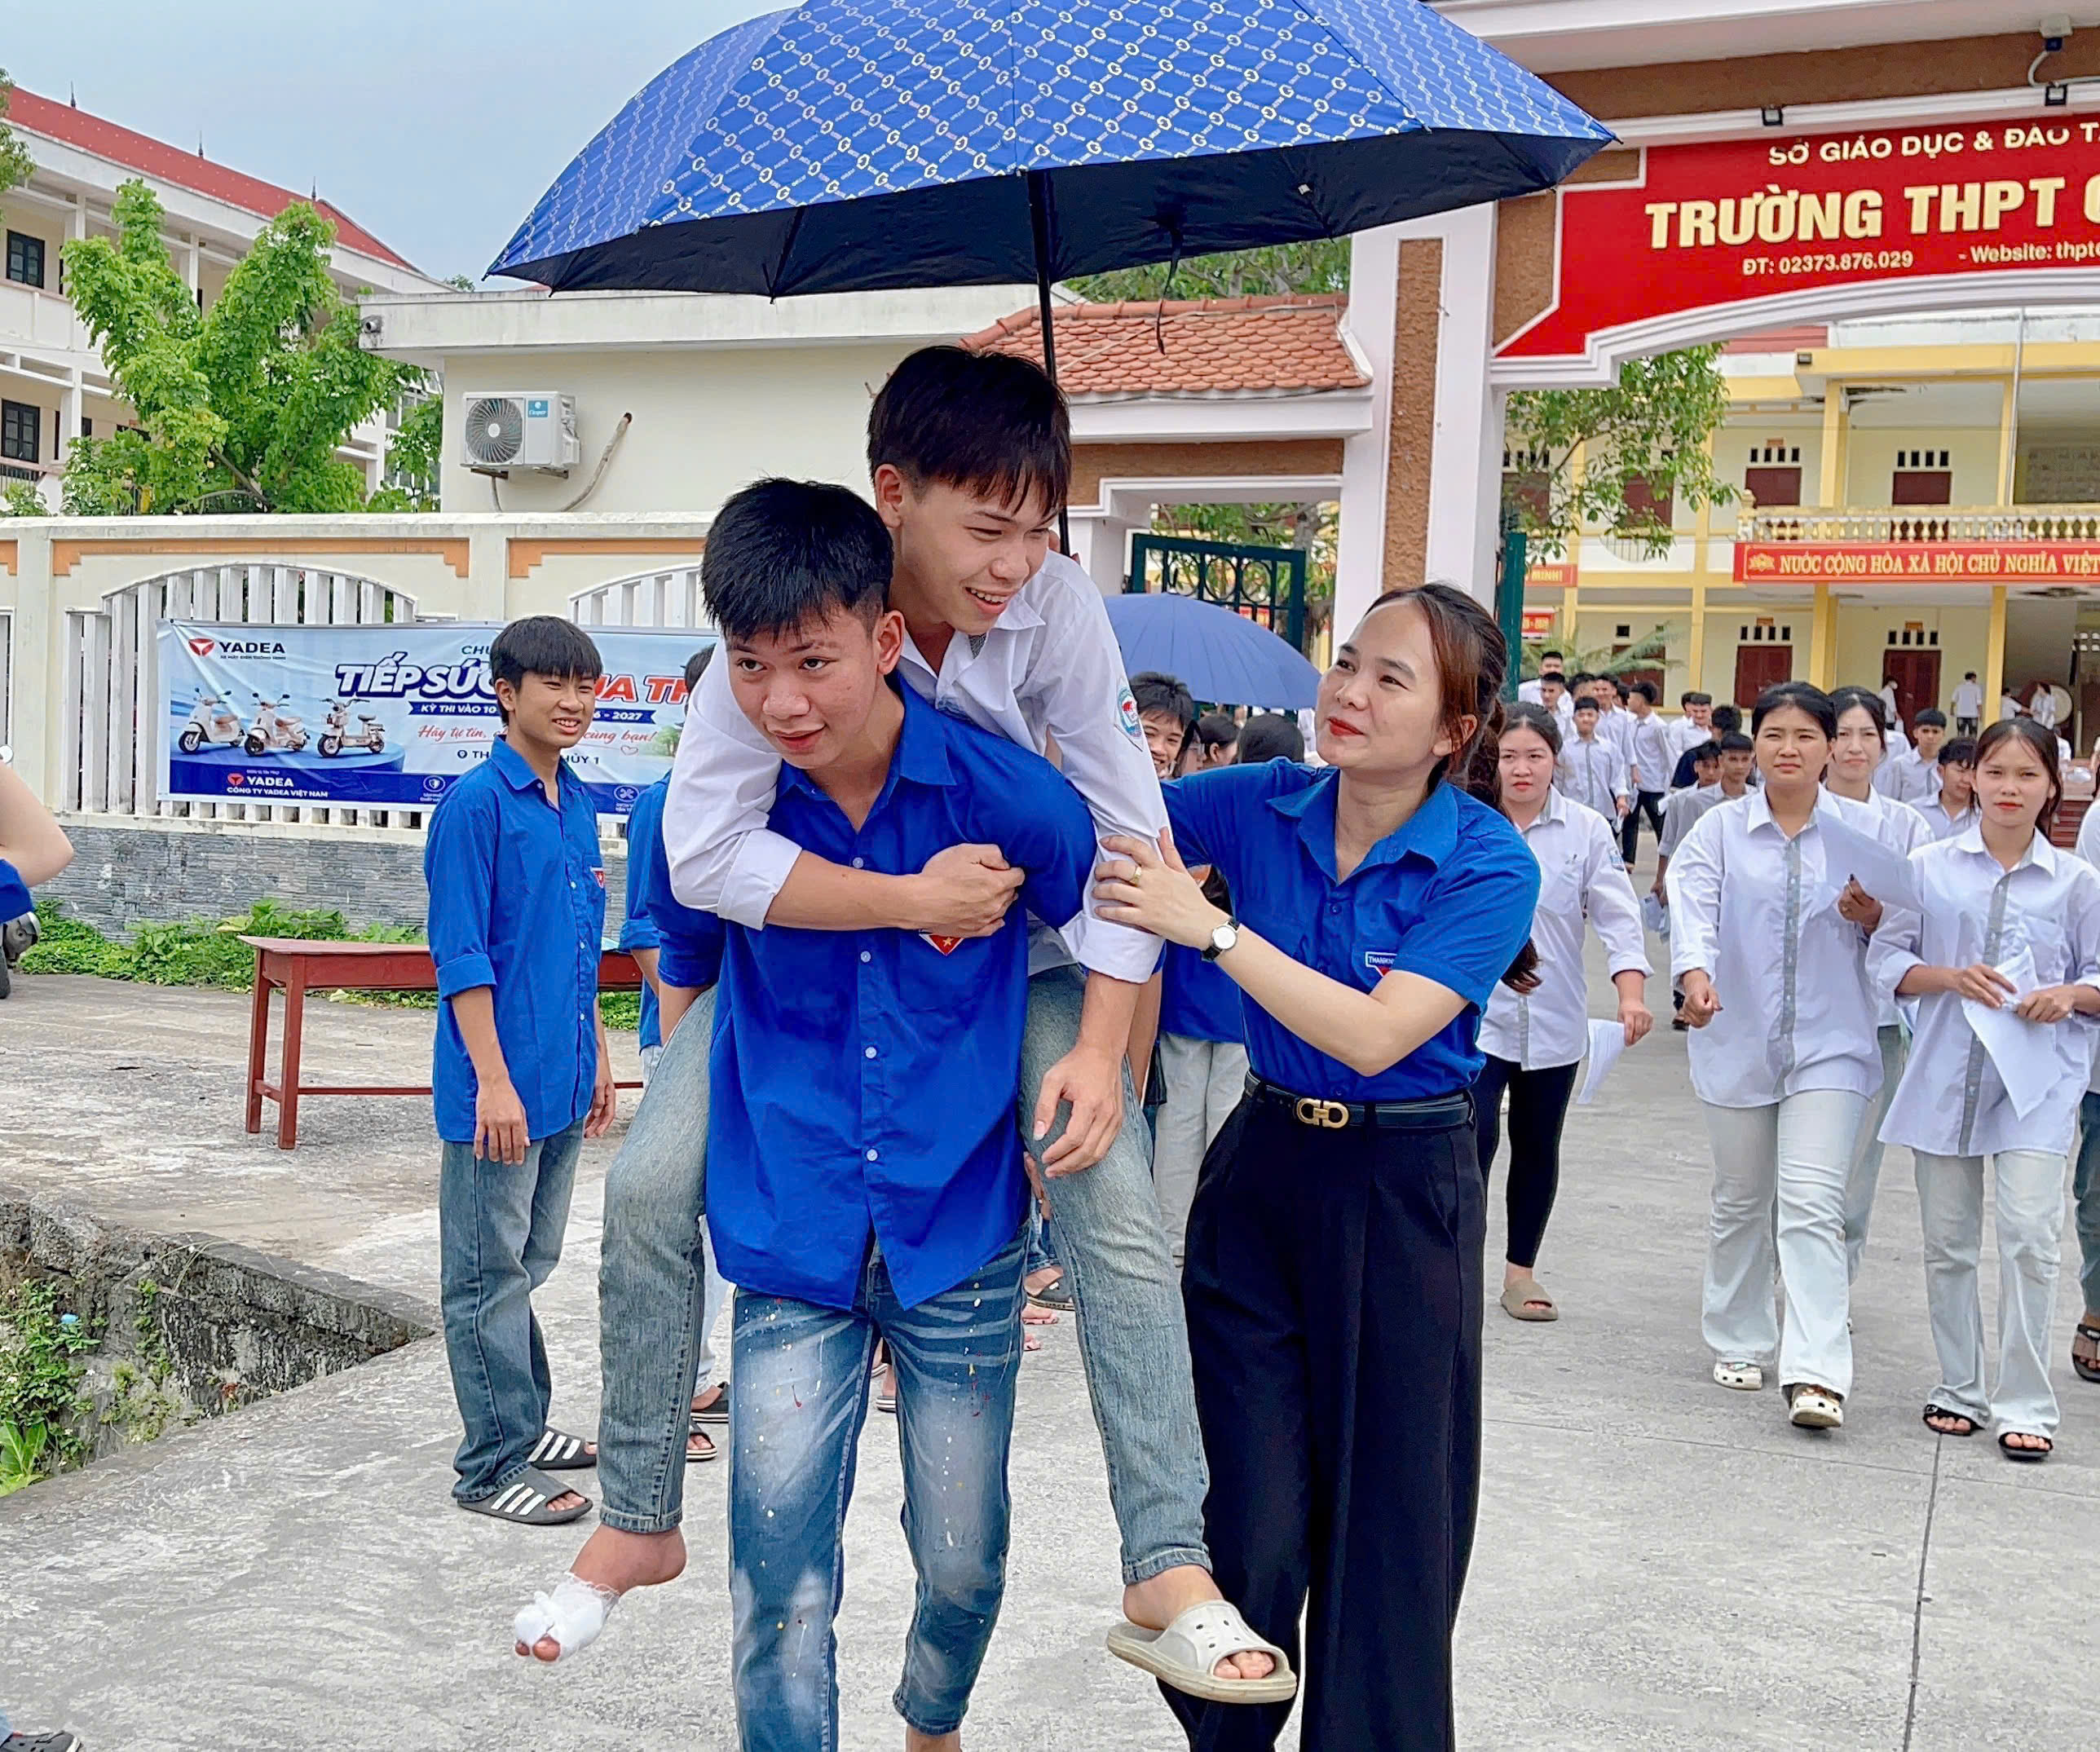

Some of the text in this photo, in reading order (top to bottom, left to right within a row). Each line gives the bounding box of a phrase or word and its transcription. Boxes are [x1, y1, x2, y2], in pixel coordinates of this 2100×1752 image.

[1819, 135, 1893, 162] GIÁO
[1901, 132, 1965, 159] DỤC
[1973, 130, 1994, 152] &
[1644, 183, 1883, 249] TRƯỜNG
[1904, 176, 2066, 235] THPT
[1742, 257, 1775, 276] ĐT:
[1779, 249, 1914, 275] 02373.876.029
[1970, 242, 2053, 263] Website:
[1824, 551, 1867, 578] CỘNG
[1870, 550, 1904, 574] HÒA
[1935, 550, 1964, 578] HỘI
[2005, 550, 2058, 574] NGHĨA
[218, 642, 286, 653] YADEA
[335, 651, 423, 698] TIẾP
[439, 703, 456, 713] THI
[457, 703, 481, 713] VÀO
[483, 705, 496, 713] 10
[611, 712, 643, 721] 2027
[593, 757, 599, 765] 1
[246, 775, 294, 787] YADEA
